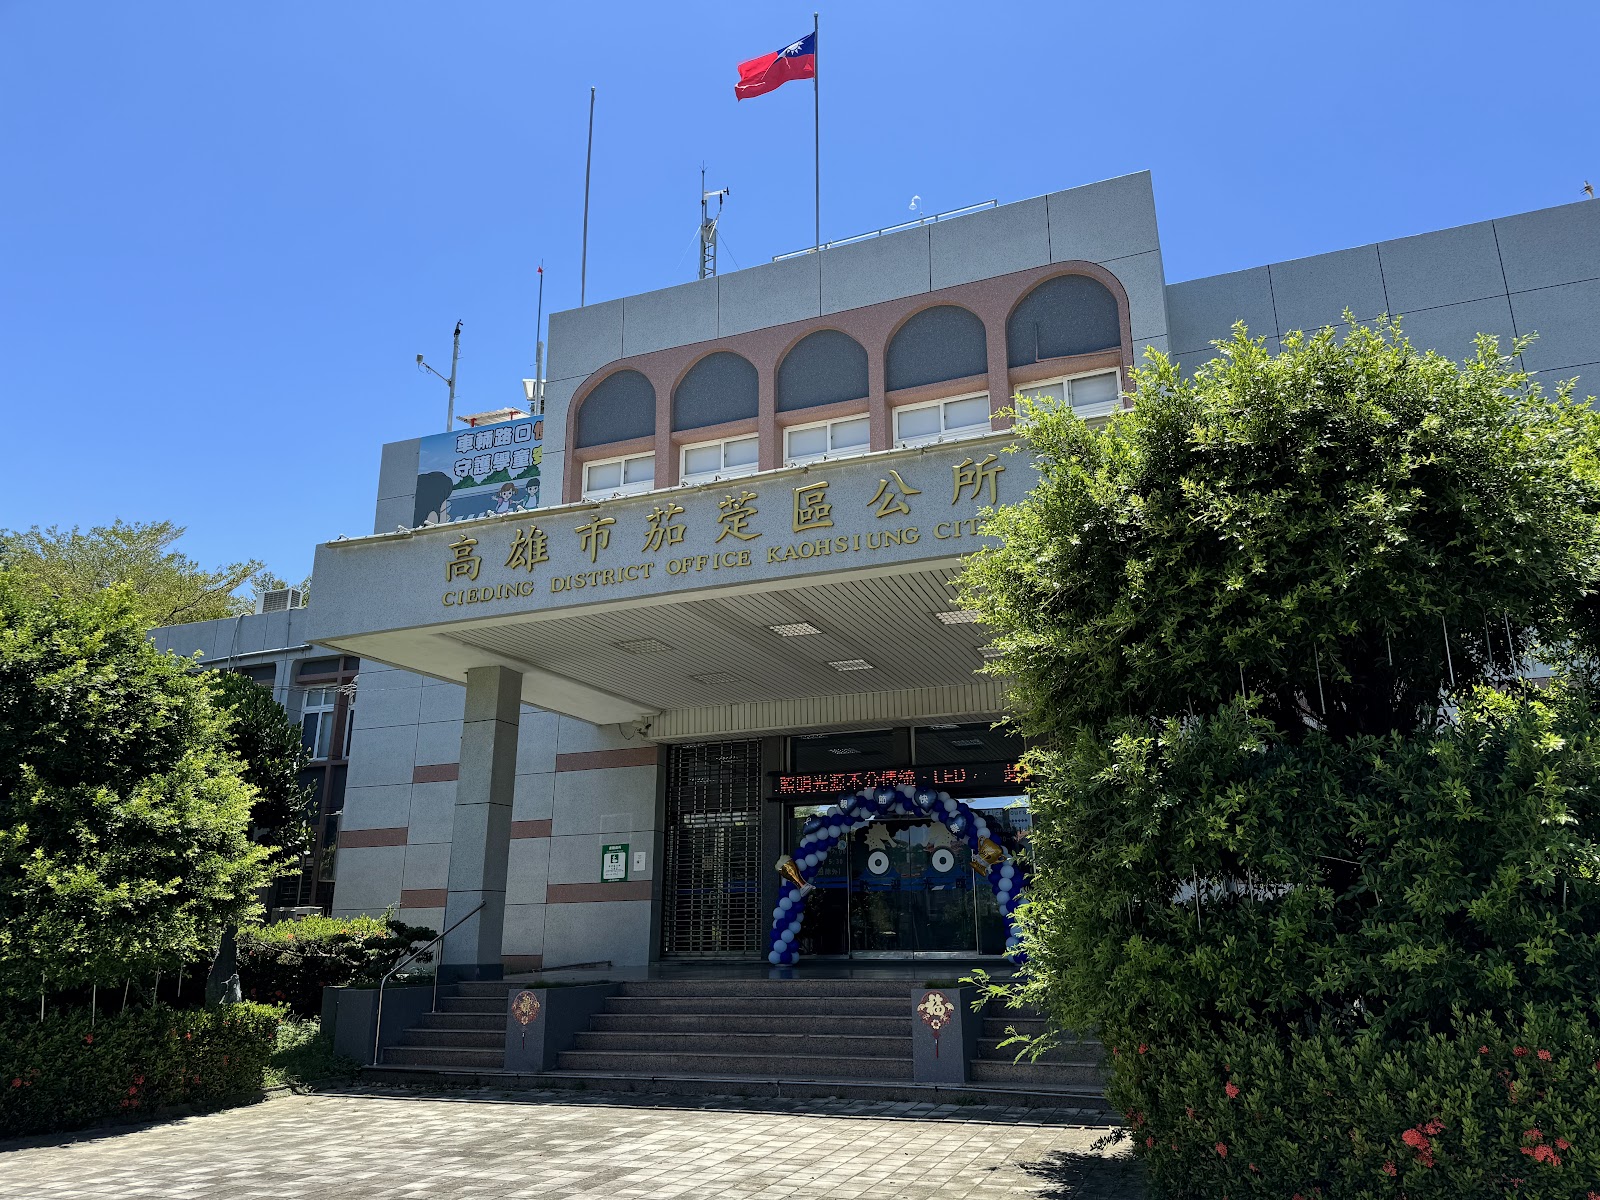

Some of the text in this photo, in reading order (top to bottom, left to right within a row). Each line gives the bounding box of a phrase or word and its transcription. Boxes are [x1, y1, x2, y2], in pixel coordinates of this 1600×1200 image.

[441, 517, 989, 606] CIEDING DISTRICT OFFICE KAOHSIUNG CIT
[445, 453, 1006, 582] 高雄市茄萣區公所
